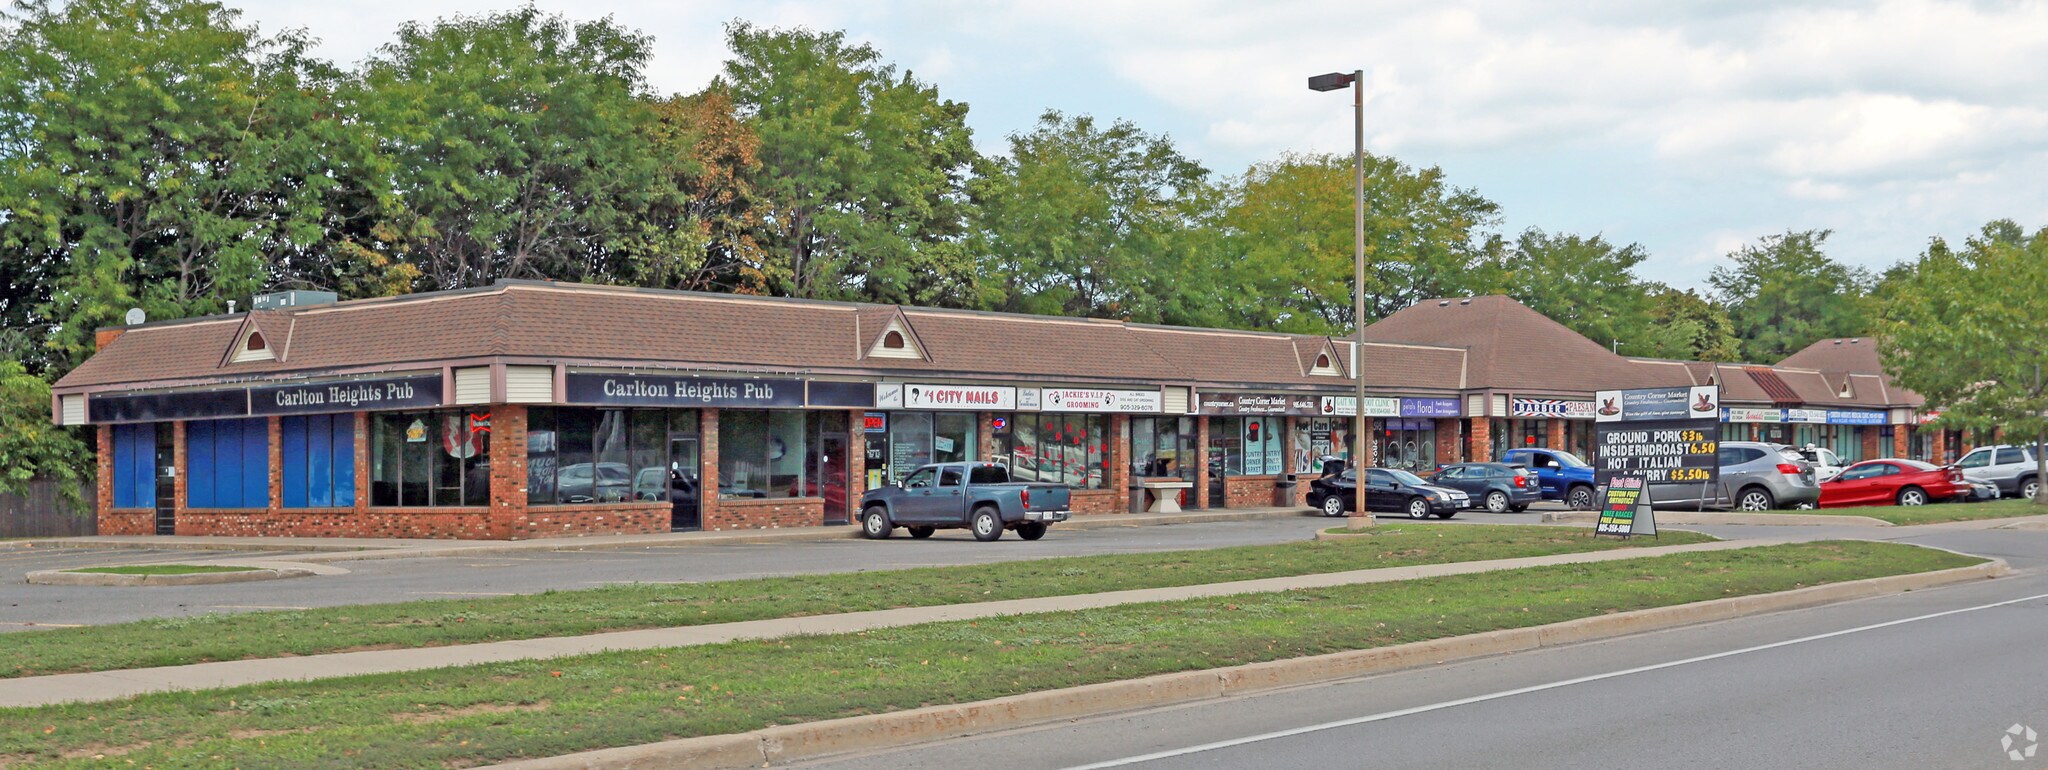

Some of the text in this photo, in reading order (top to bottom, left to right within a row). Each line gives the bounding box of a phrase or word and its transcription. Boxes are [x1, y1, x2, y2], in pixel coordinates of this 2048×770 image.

[276, 382, 413, 406] Carlton Heights Pub
[604, 379, 774, 402] Carlton Heights Pub
[1062, 391, 1089, 399] JACKIE'S
[924, 390, 999, 404] #1 CITY NAILS
[1238, 396, 1255, 405] Country
[1270, 397, 1286, 405] Market
[1375, 399, 1390, 407] CLINIC
[1417, 401, 1434, 414] floral
[1518, 403, 1561, 413] BARBER
[864, 417, 883, 428] OPEN
[1314, 420, 1328, 430] Care
[1607, 431, 1648, 444] GROUND
[1654, 430, 1681, 443] PORK
[1690, 442, 1715, 454] 6.50
[1607, 456, 1682, 469] HOT ITALIAN
[1624, 478, 1642, 489] Clinic
